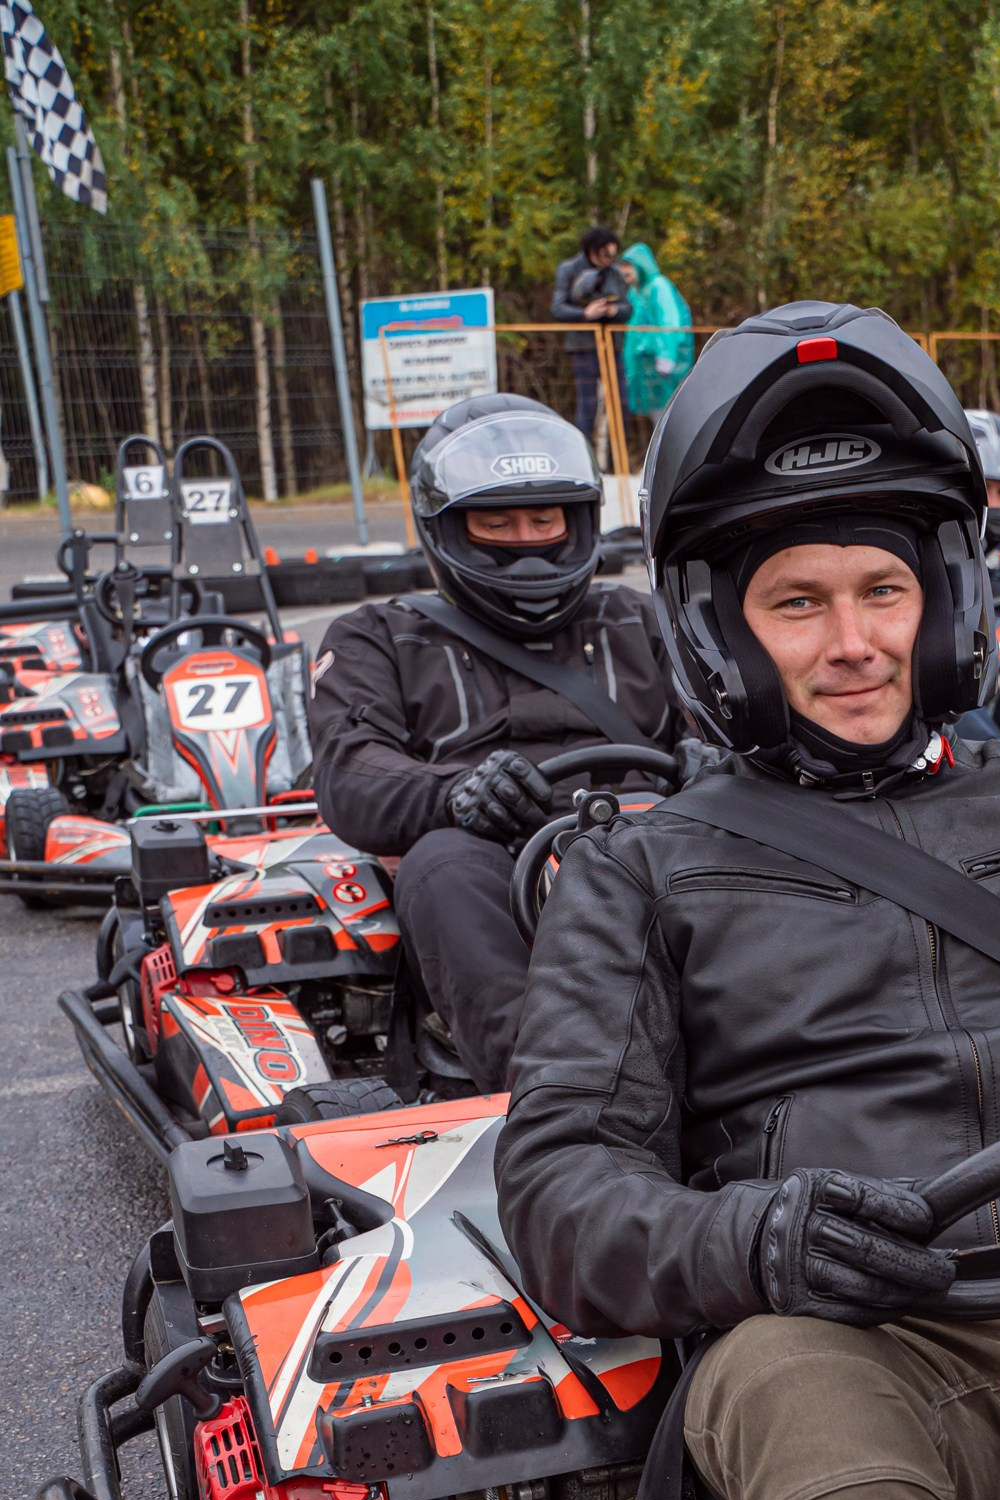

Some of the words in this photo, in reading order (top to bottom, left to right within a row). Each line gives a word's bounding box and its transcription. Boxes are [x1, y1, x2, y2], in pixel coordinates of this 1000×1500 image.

[500, 456, 552, 476] SHOEI
[781, 440, 865, 471] HJC
[135, 471, 153, 494] 6
[188, 490, 225, 513] 27
[186, 681, 252, 719] 27
[222, 1004, 302, 1083] DINO
